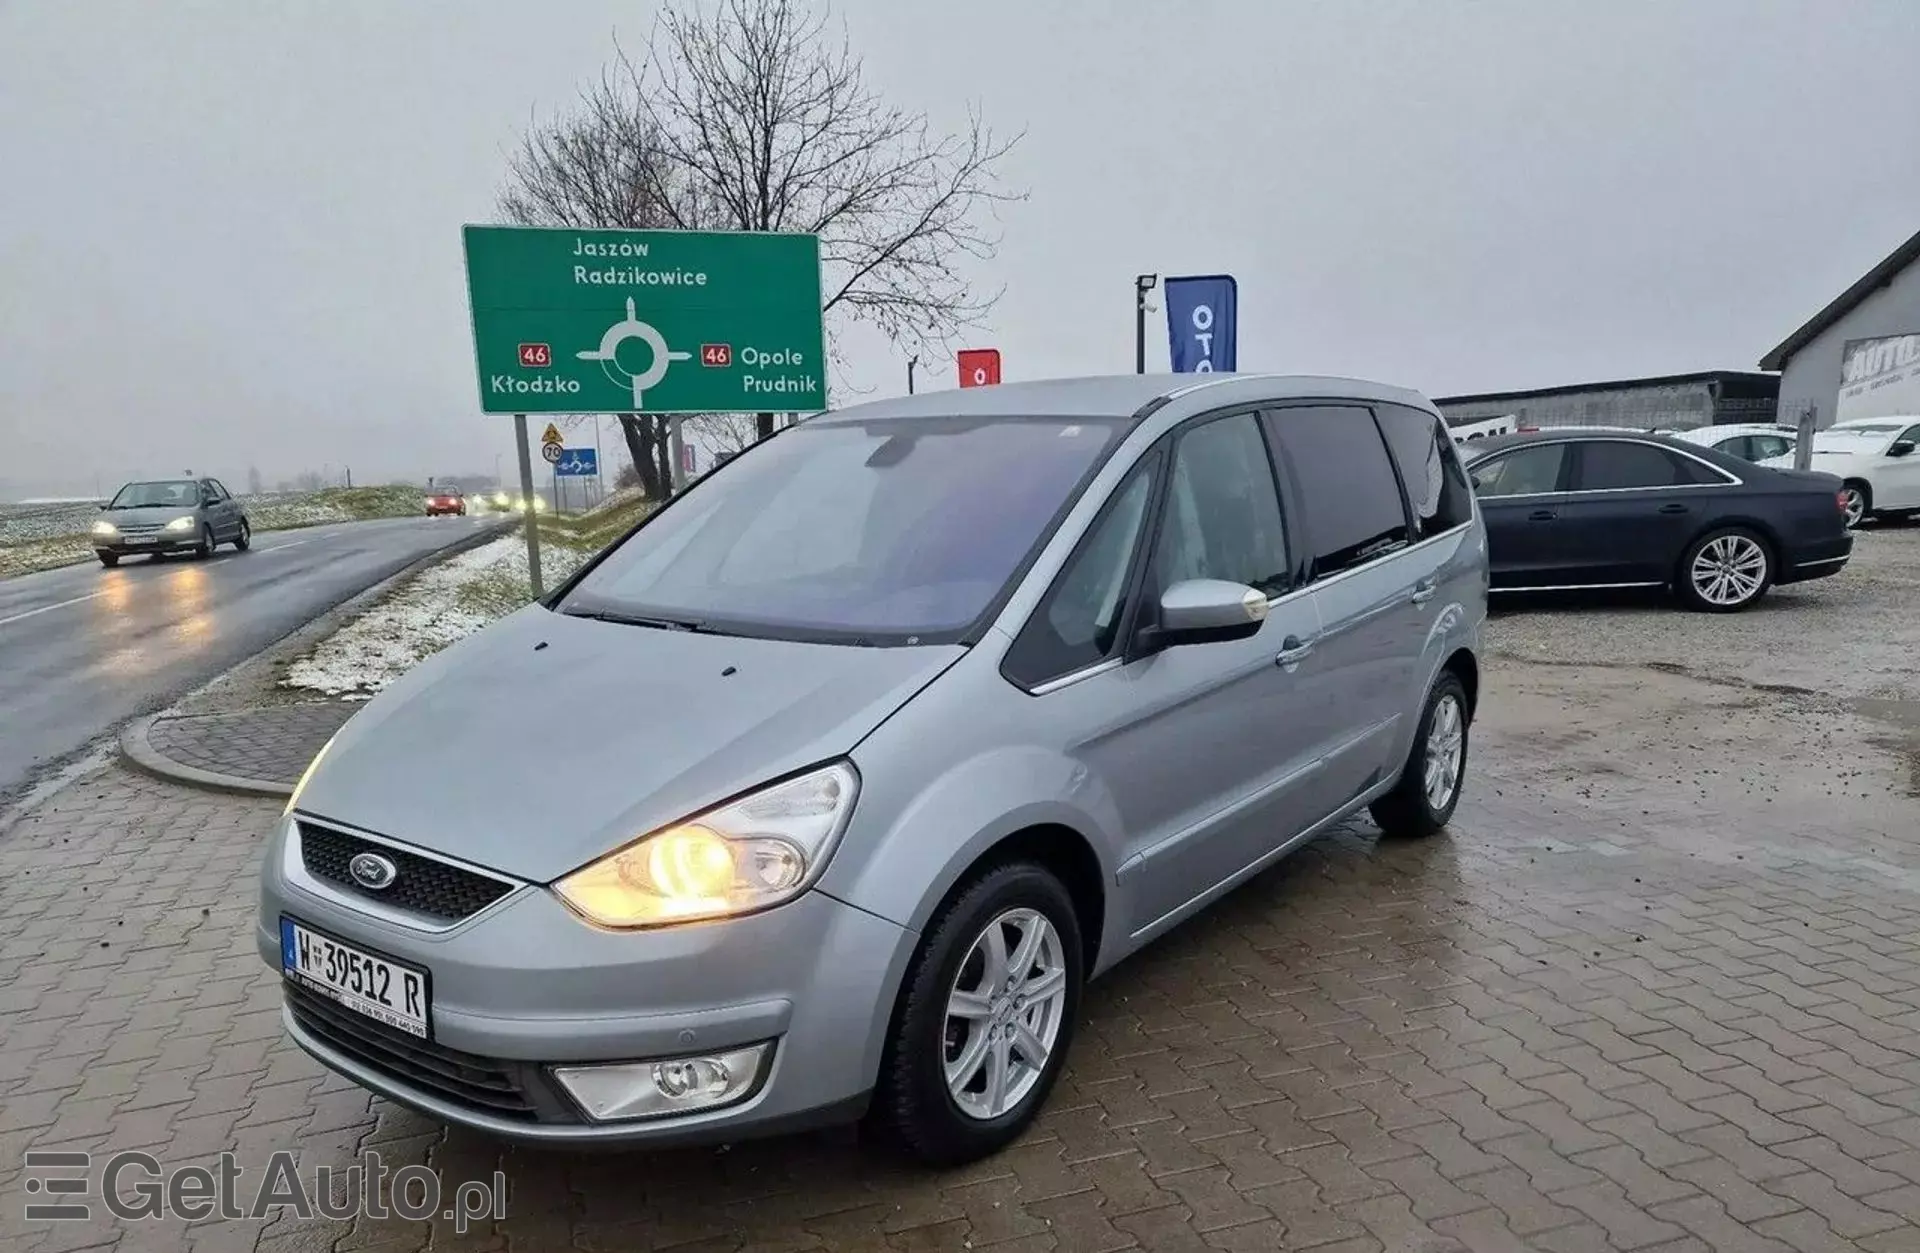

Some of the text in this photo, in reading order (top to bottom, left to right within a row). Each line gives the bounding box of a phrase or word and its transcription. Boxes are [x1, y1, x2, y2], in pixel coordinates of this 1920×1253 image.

[573, 238, 649, 257] Jaszów
[574, 265, 707, 285] Radzikowice
[523, 348, 547, 364] 46
[705, 347, 728, 364] 46
[741, 347, 803, 369] Opole
[491, 375, 580, 393] Kłodzko
[743, 375, 817, 393] Prudnik
[546, 447, 561, 458] 70
[323, 941, 393, 1007] 39512
[403, 972, 421, 1018] R
